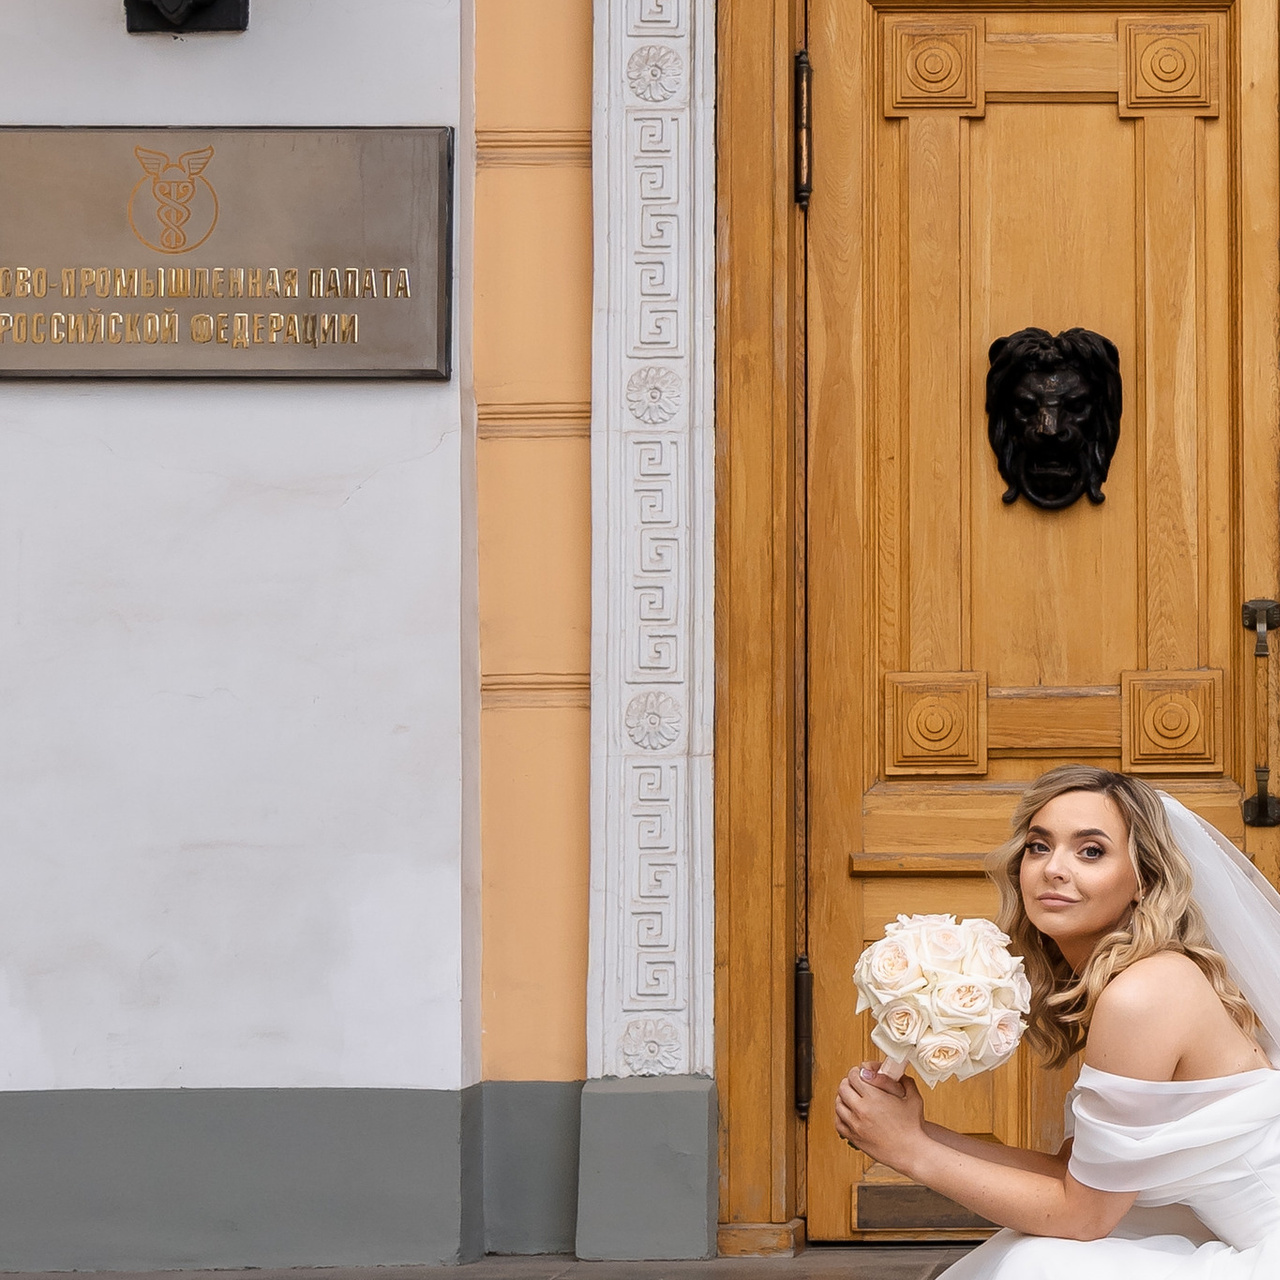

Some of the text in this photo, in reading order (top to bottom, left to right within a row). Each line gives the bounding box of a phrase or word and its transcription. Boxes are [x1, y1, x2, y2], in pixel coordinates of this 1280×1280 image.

[307, 267, 412, 299] ПАЛАТА
[0, 306, 360, 349] РОССИЙСКОЙ ФЕДЕРАЦИИ
